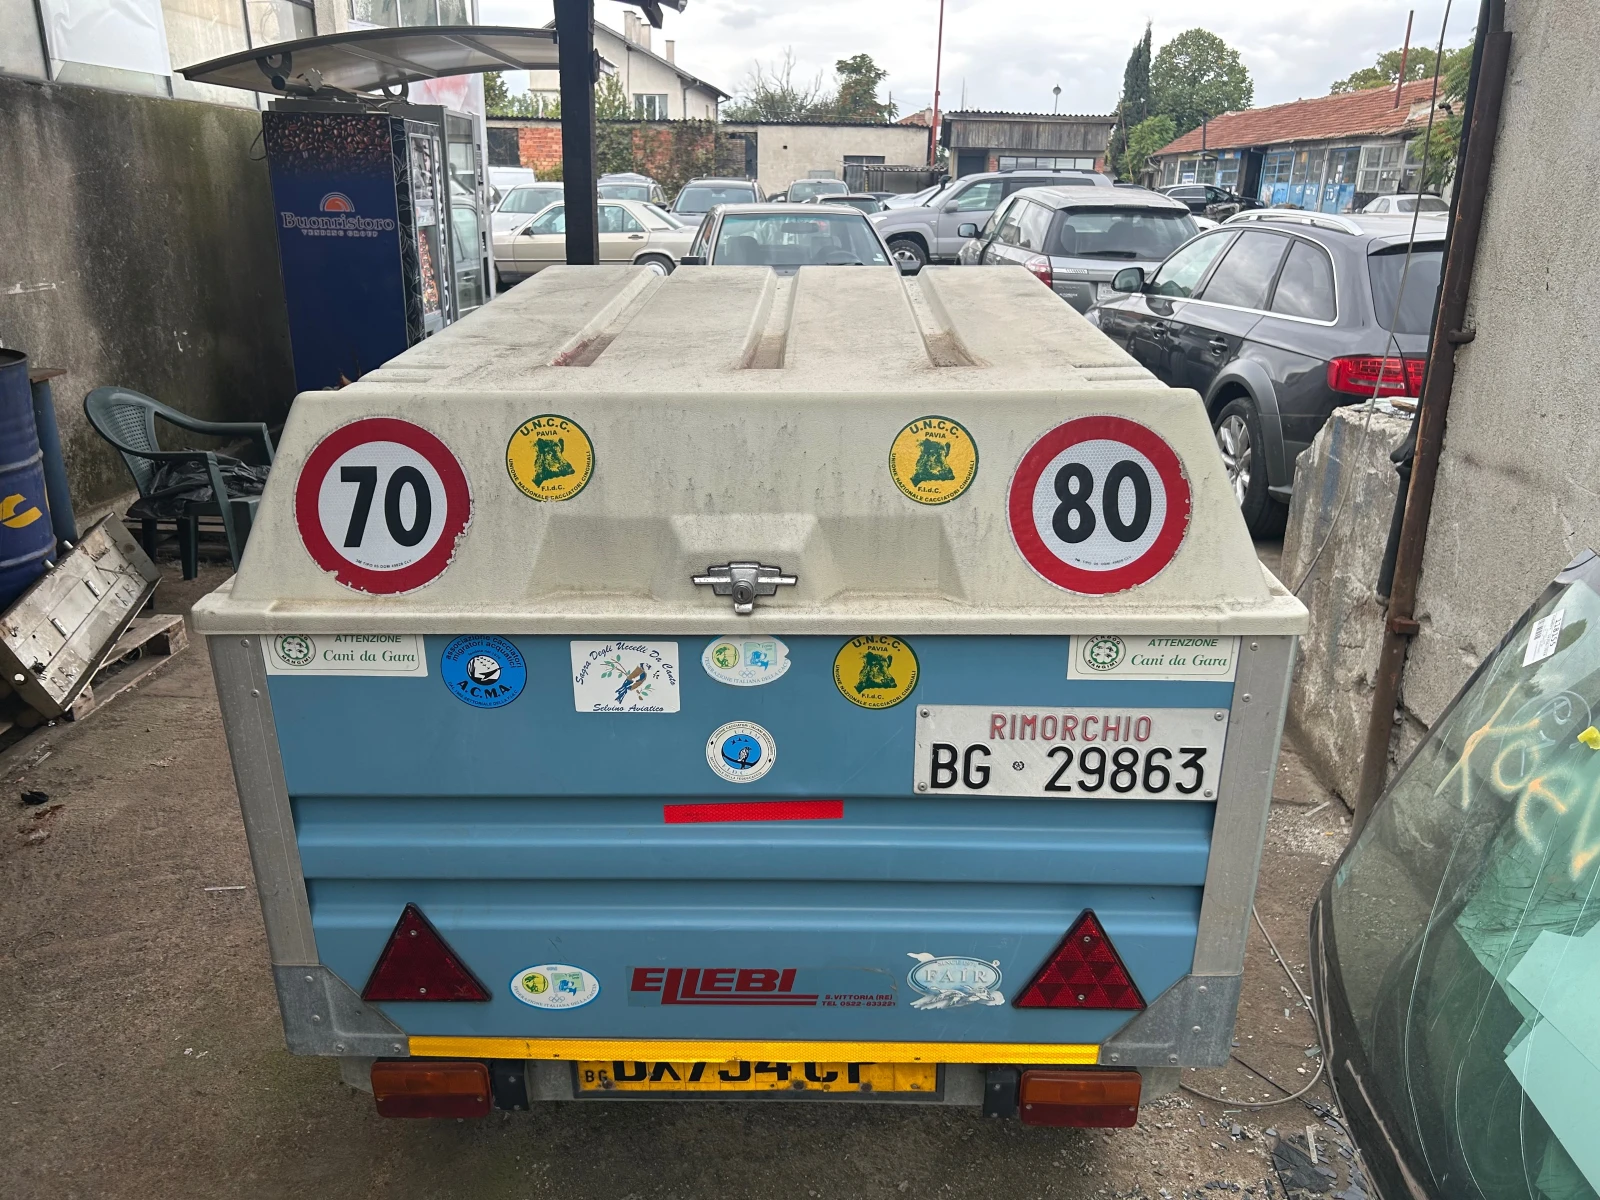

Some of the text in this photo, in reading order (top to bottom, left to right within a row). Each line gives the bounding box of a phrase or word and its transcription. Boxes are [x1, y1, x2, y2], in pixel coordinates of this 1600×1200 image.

[281, 212, 395, 231] Buonristoro
[508, 450, 591, 500] UNIONE NAZIONALE CACCIATORI CINGHIALI
[896, 478, 923, 500] NAZIONALE
[925, 489, 960, 502] CACCIATORI
[960, 460, 974, 489] CINGHIALI
[340, 466, 432, 547] 70
[1052, 460, 1152, 543] 80
[281, 654, 311, 664] MANGIMI
[323, 650, 416, 662] Cani da Gara
[446, 635, 523, 668] associazione cacciatori
[453, 641, 483, 662] migratori
[486, 642, 517, 668] acquatici
[576, 642, 676, 686] Sagra Degli Uccelli Da Canto
[1088, 659, 1117, 669] MANGIMI
[1131, 654, 1227, 666] Cani da Gara
[705, 657, 733, 682] FEDERAZIONE
[762, 673, 777, 682] DELLA
[456, 680, 512, 699] A.C.M.A.
[840, 685, 867, 706] NAZIONALE
[868, 695, 902, 707] CACCIATORI
[902, 671, 916, 695] CINGHIALI
[593, 704, 624, 712] Selvino
[990, 714, 1152, 742] RIMORCHIO
[930, 743, 1207, 793] BG 29863
[514, 985, 542, 1006] FEDERAZIONE
[630, 968, 797, 1005] ELLEBI
